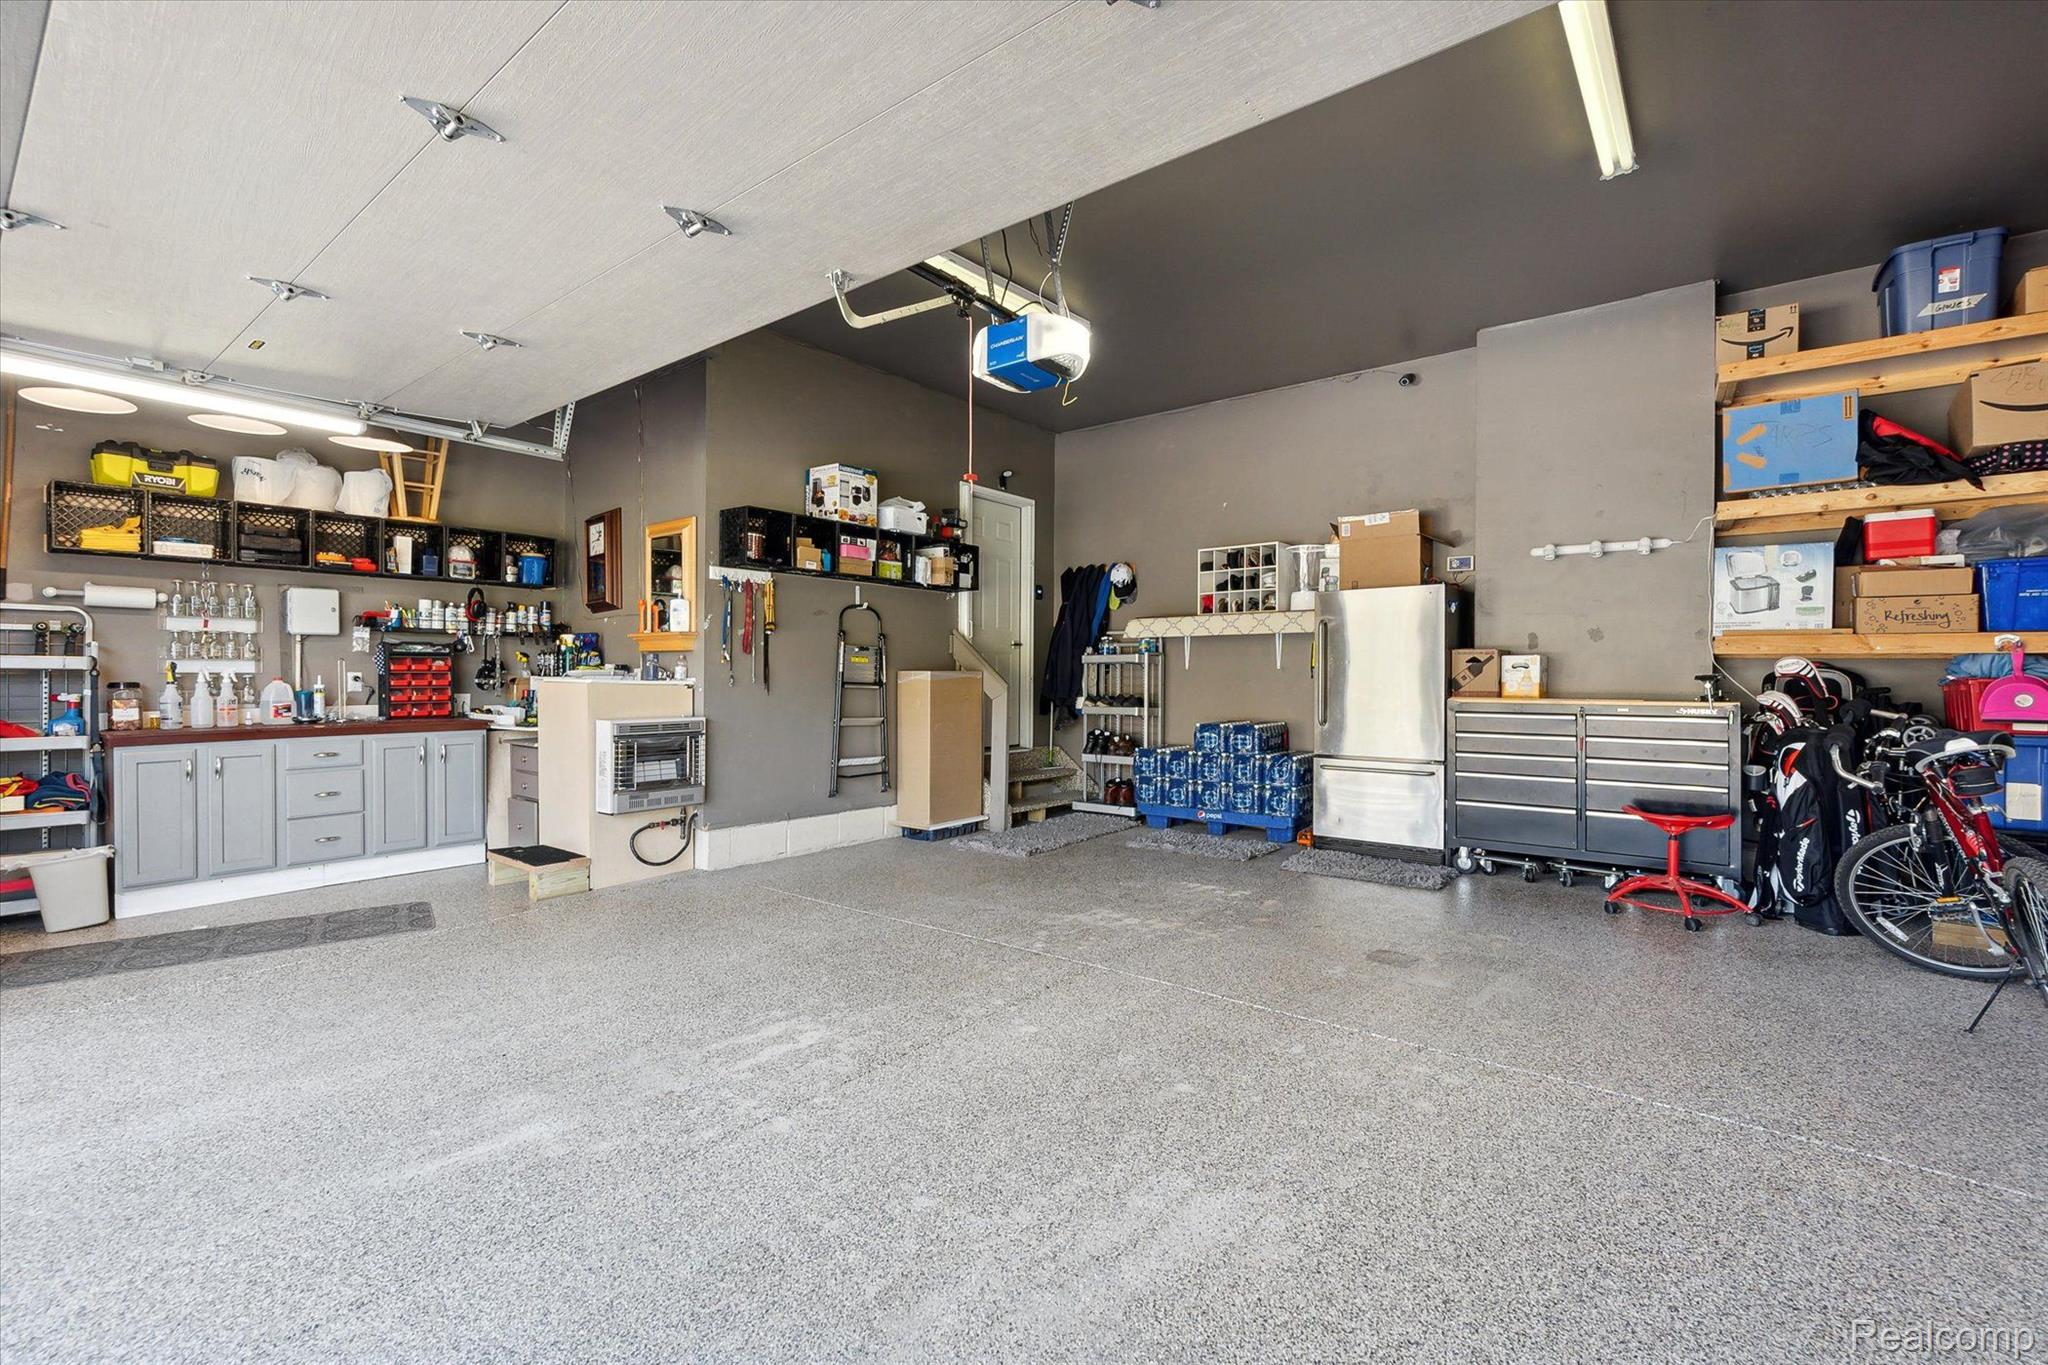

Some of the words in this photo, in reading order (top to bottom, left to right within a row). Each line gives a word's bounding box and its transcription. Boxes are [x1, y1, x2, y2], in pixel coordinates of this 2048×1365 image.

[143, 474, 176, 486] RYOBI
[1884, 609, 1952, 629] Refreshing
[1793, 837, 1810, 893] TaylorMade
